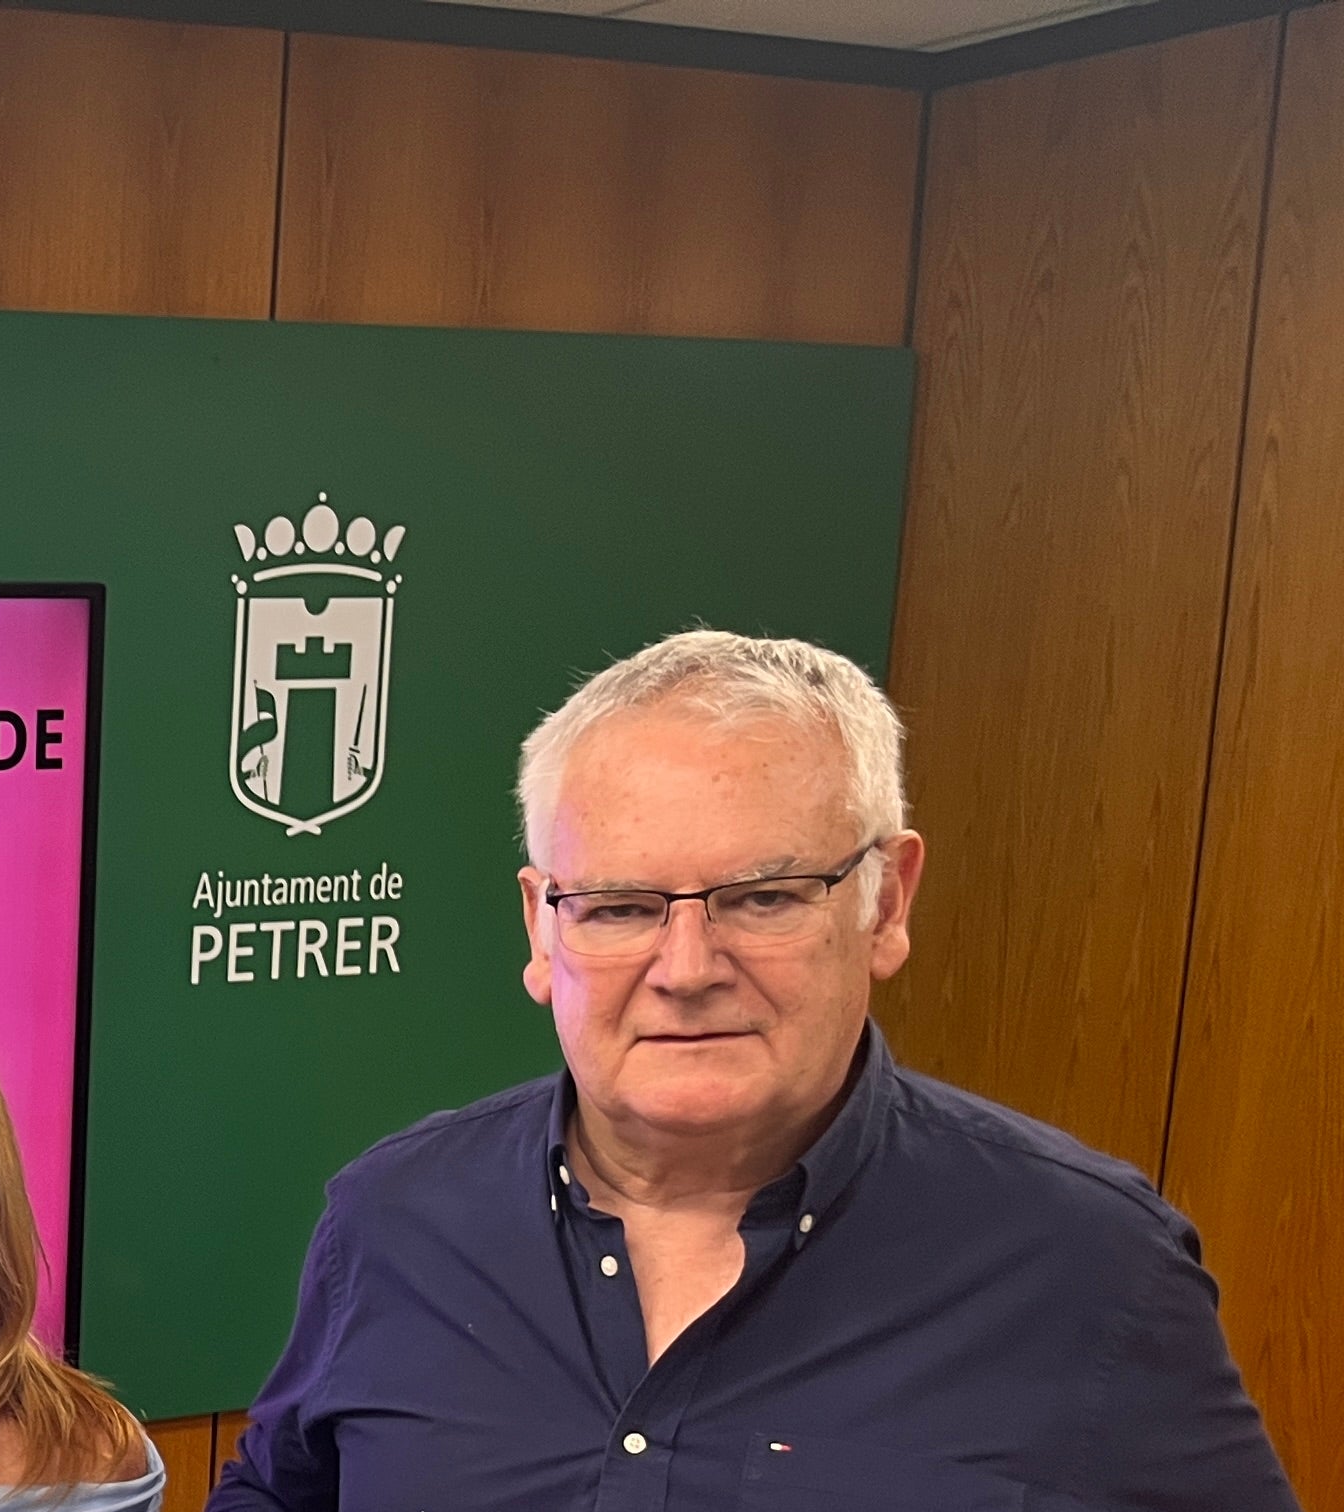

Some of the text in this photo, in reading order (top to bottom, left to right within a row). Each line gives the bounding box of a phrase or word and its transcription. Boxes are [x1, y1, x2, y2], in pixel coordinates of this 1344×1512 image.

[192, 862, 403, 918] Ajuntament de
[191, 915, 401, 985] PETRER
